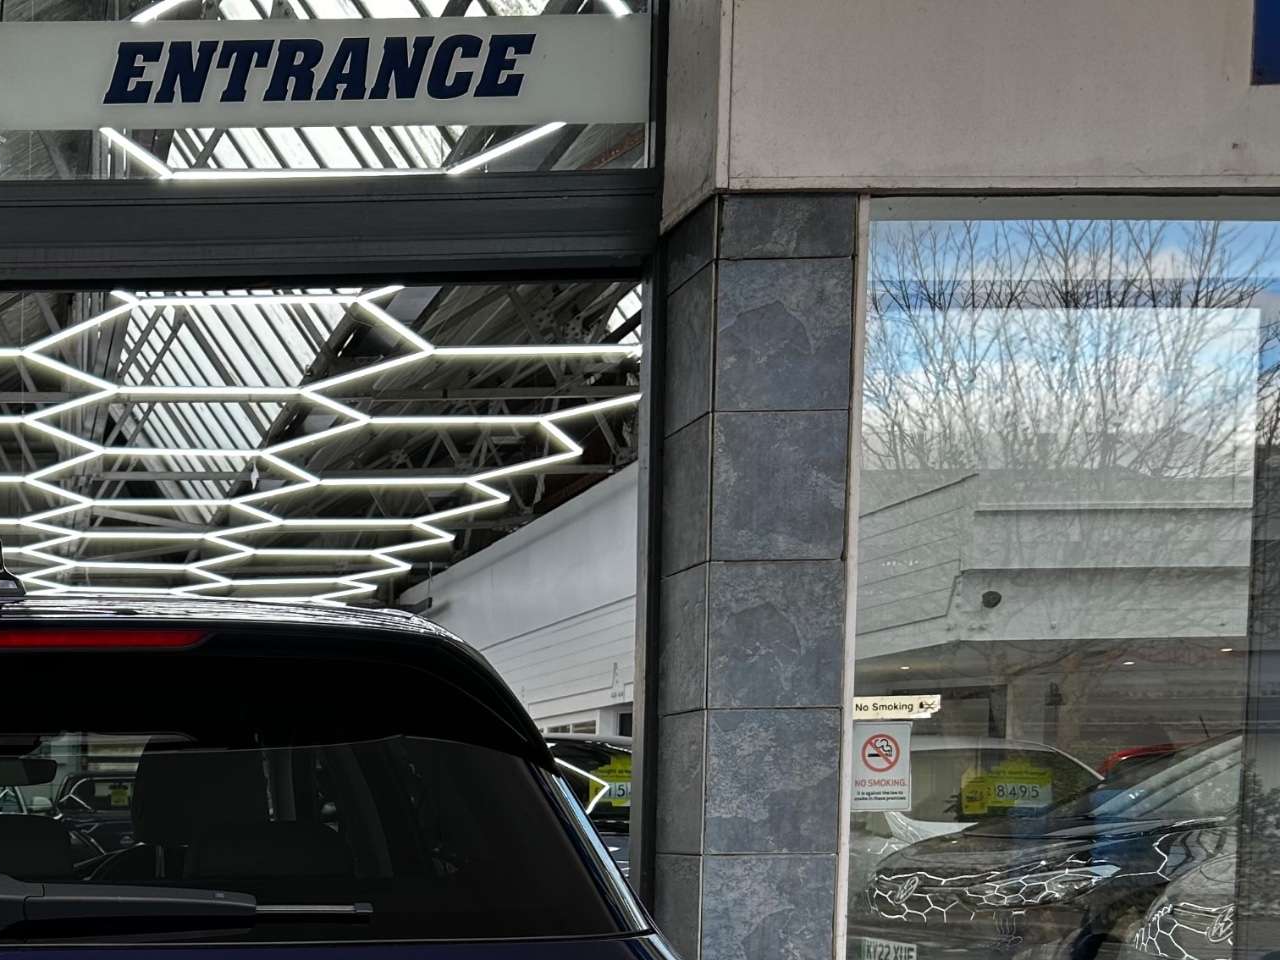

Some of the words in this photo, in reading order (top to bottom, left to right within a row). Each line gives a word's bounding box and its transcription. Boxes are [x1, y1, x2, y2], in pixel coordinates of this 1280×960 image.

[103, 33, 537, 104] ENTRANCE
[855, 703, 869, 711] No
[872, 702, 914, 712] Smoking
[855, 779, 866, 787] NO
